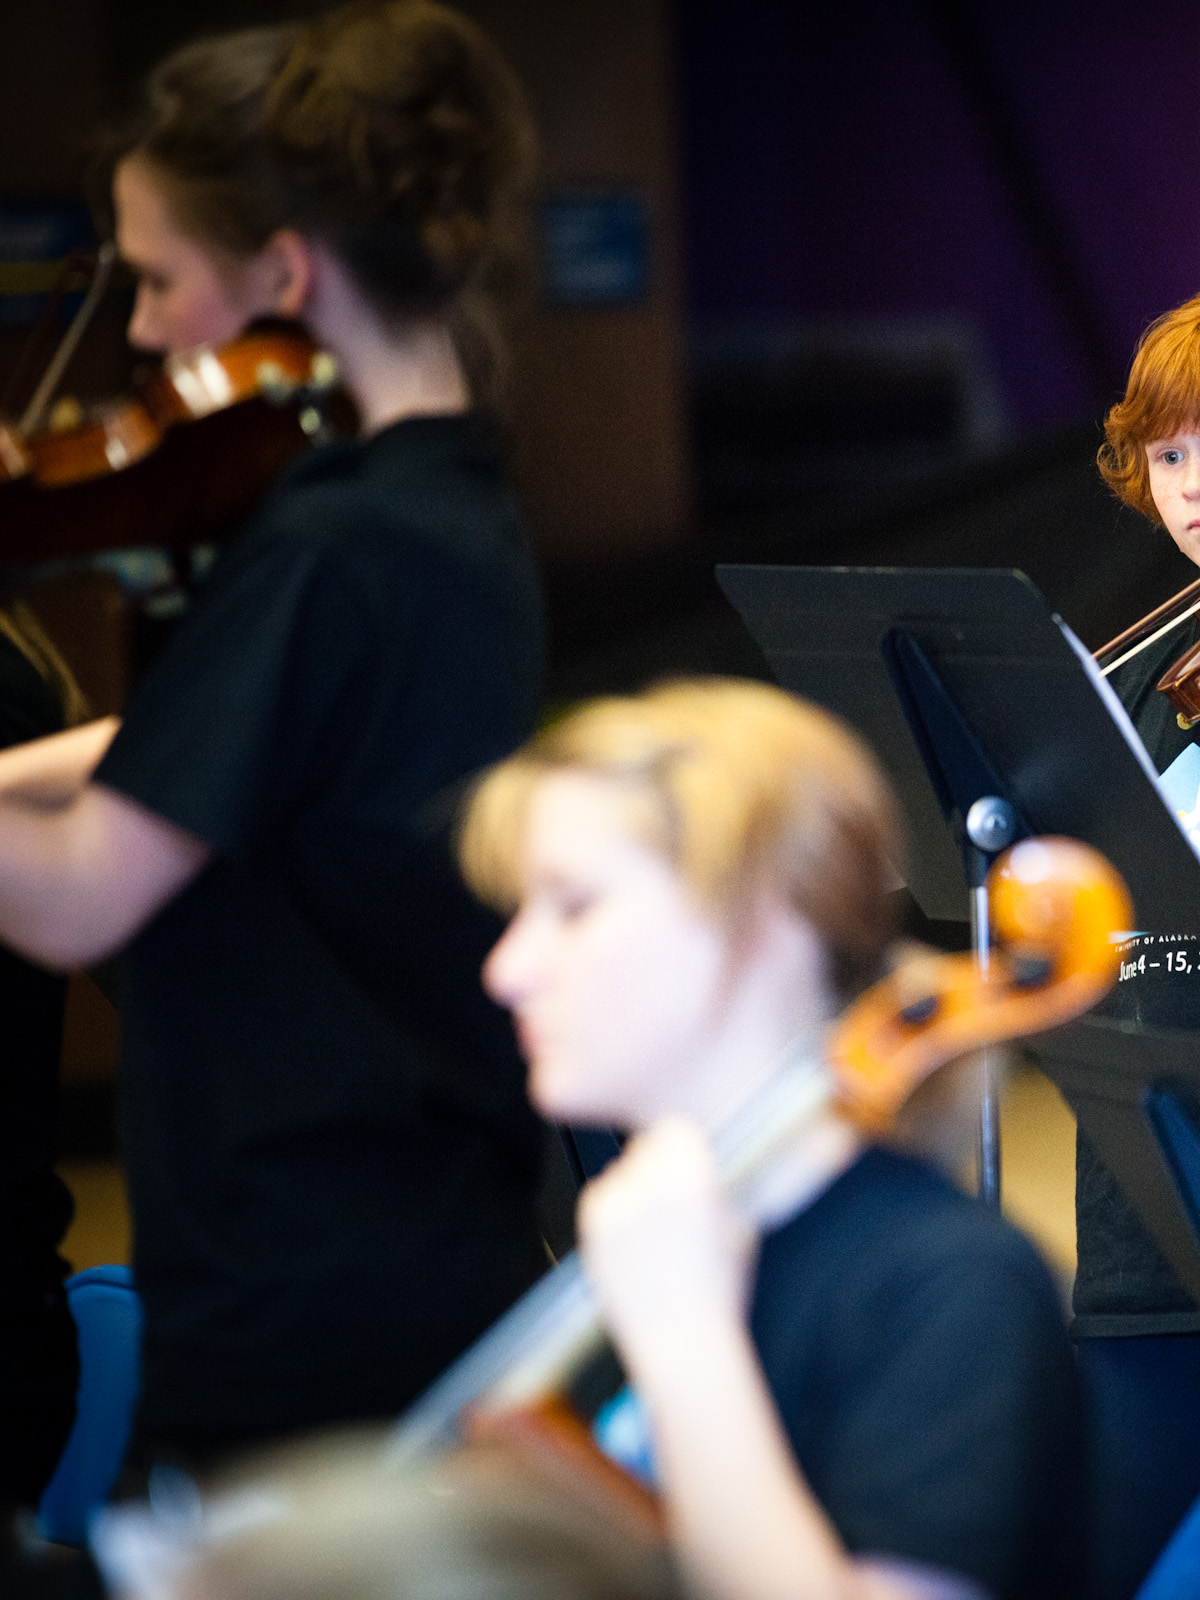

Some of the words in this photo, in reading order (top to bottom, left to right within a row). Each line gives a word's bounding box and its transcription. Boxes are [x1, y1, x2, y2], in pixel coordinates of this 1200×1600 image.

[1144, 936, 1154, 945] OF
[1159, 934, 1197, 943] ALASKA
[1119, 961, 1137, 982] June
[1137, 954, 1146, 974] 4
[1166, 951, 1193, 974] 15,
